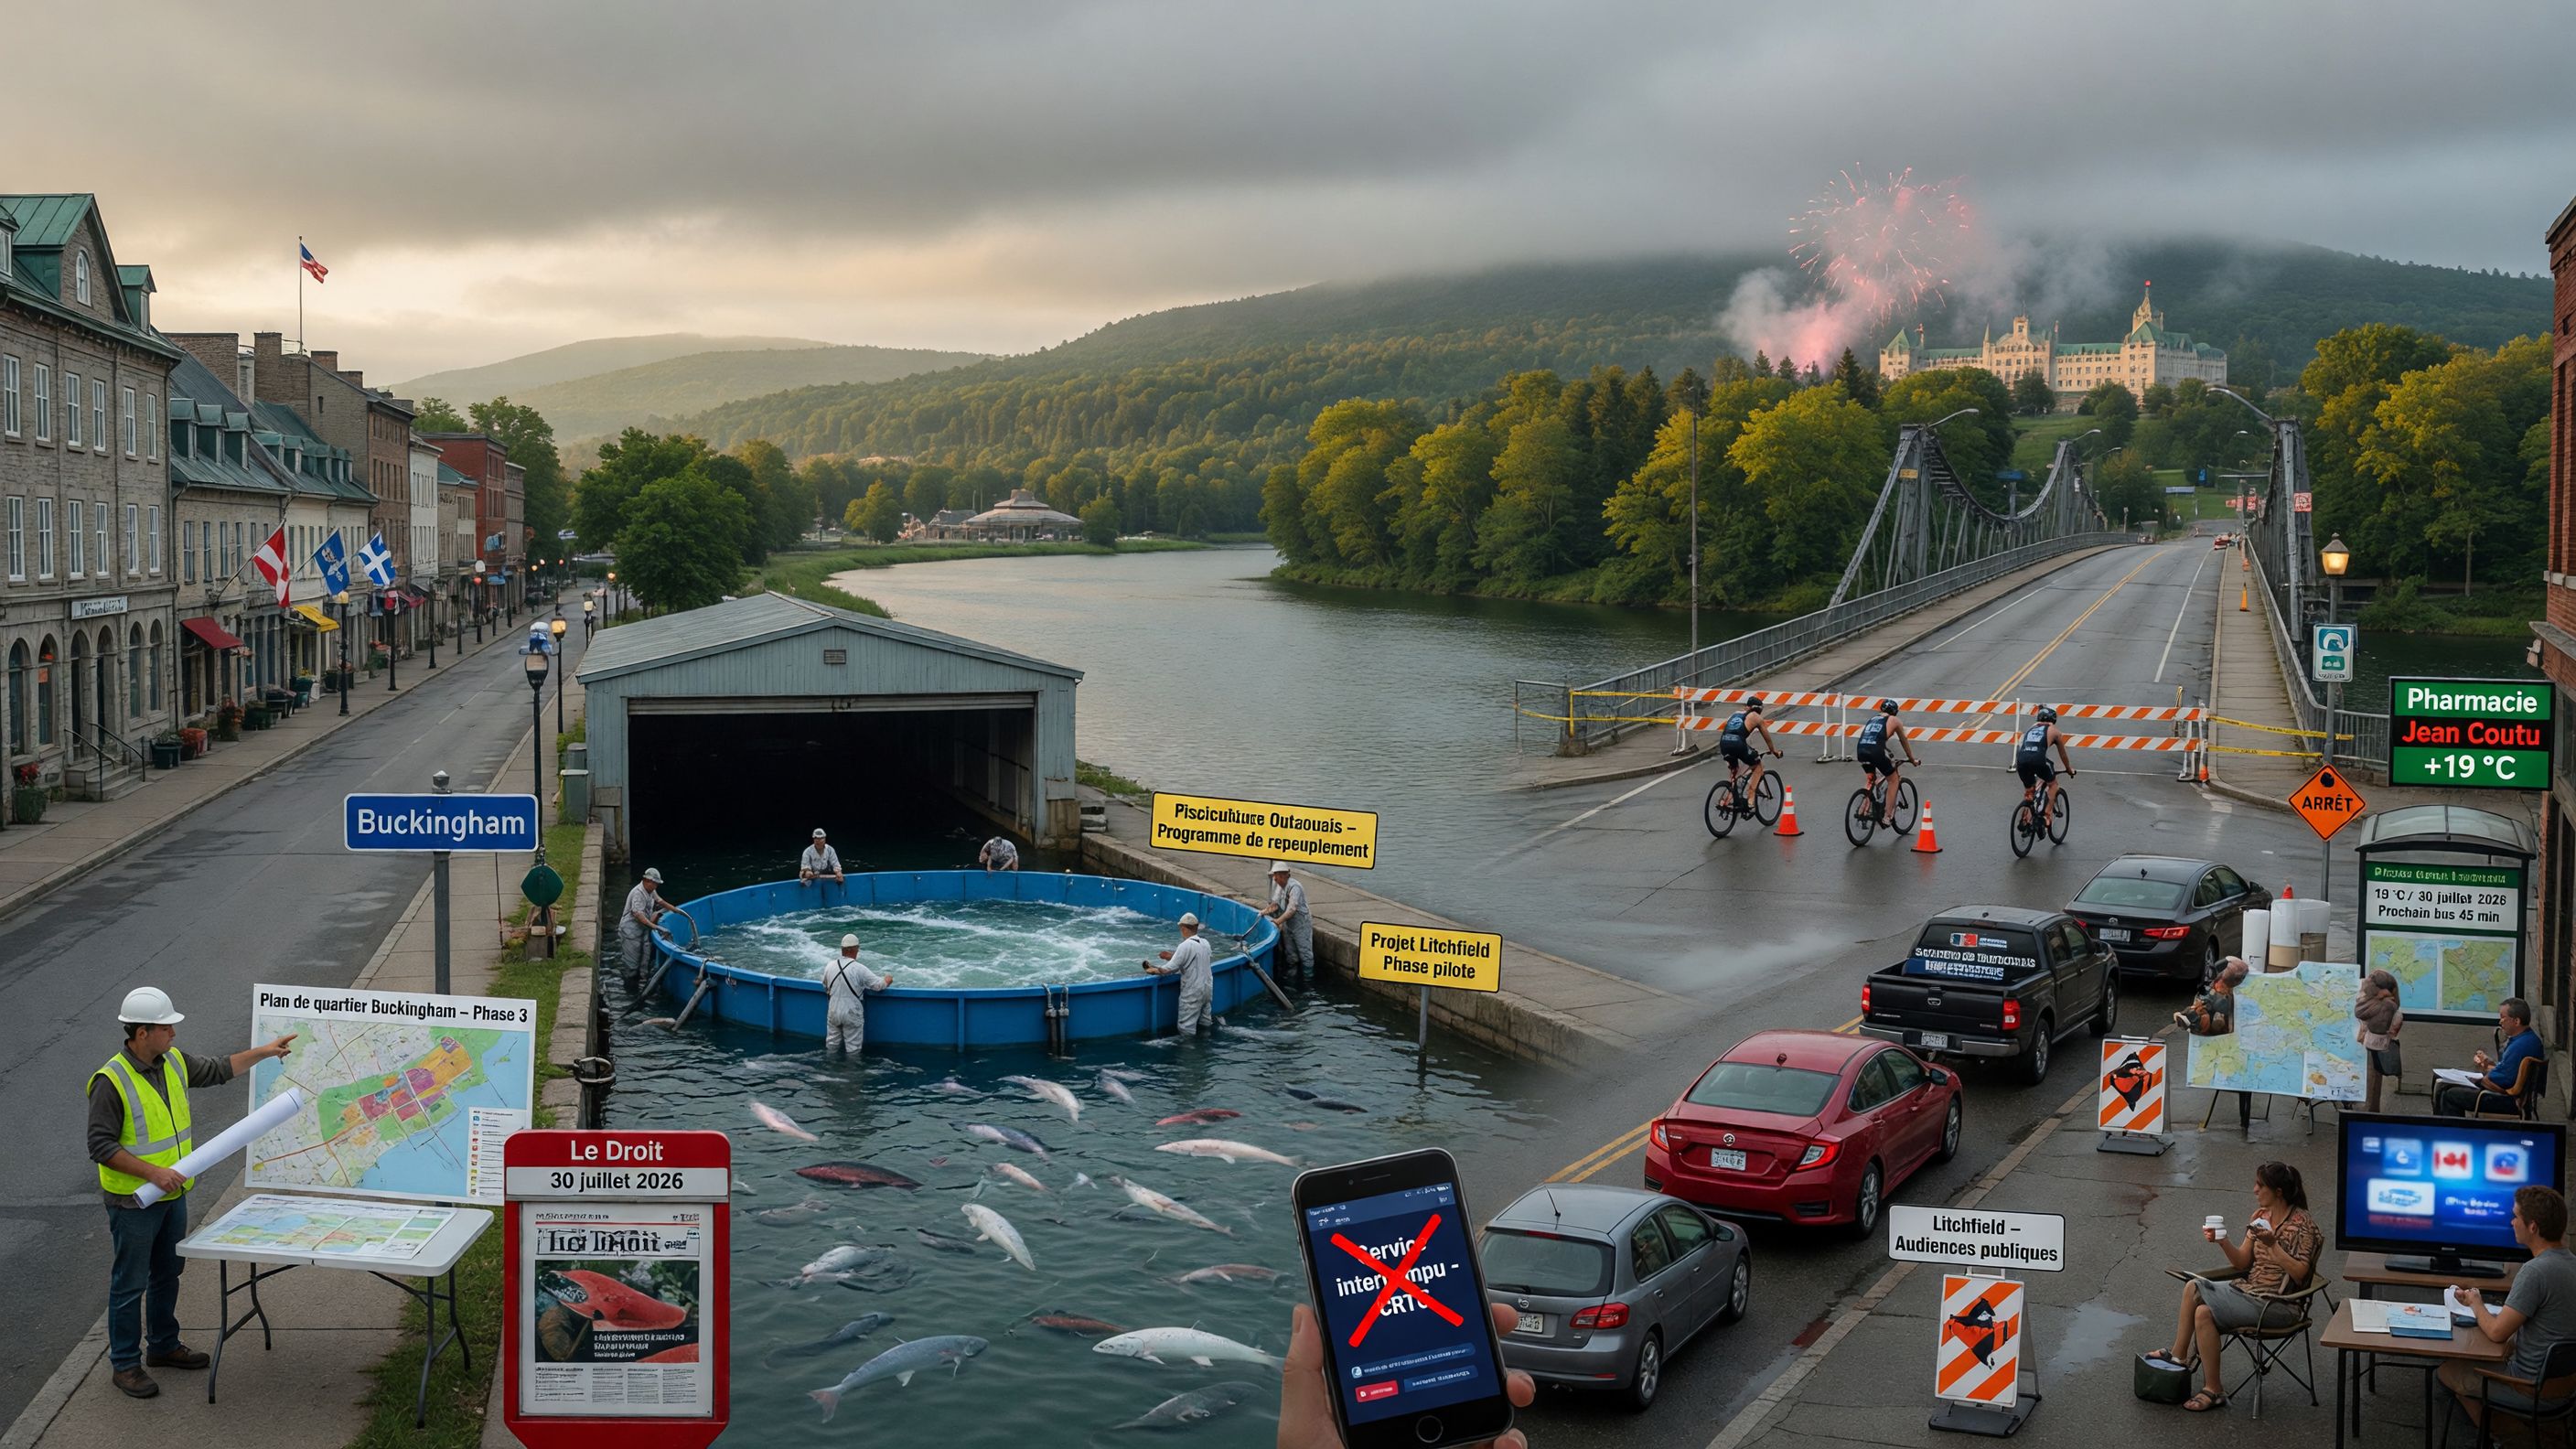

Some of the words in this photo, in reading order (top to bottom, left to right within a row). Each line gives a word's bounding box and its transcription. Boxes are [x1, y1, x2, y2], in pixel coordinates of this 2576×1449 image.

[2408, 688, 2538, 714] Pharmacie
[2402, 721, 2460, 744] Jean
[2468, 722, 2540, 746] Coutu
[2424, 754, 2475, 778] +19
[2483, 756, 2517, 780] °C
[2302, 794, 2354, 812] ARRÊT
[358, 809, 525, 842] Buckingham
[1270, 812, 1343, 833] Outaouais
[1157, 823, 1241, 845] Programme
[1246, 832, 1263, 847] de
[1268, 837, 1369, 858] repeuplement
[2418, 891, 2432, 902] 30
[2477, 894, 2507, 906] 2026
[2378, 905, 2431, 918] Prochain
[2434, 907, 2455, 920] bus
[2459, 909, 2474, 921] 45
[2477, 911, 2500, 922] min
[1371, 932, 1415, 952] Projet
[1420, 937, 1490, 959] Litchfield
[1383, 955, 1429, 974] Phase
[1433, 961, 1476, 979] pilote
[260, 993, 290, 1008] Plan
[294, 994, 310, 1009] de
[314, 996, 368, 1014] quartier
[371, 999, 456, 1020] Buckingham
[473, 1005, 515, 1022] Phase
[519, 1008, 528, 1023] 3
[571, 1140, 599, 1161] Le
[606, 1140, 664, 1162] Droit
[551, 1172, 574, 1189] 30
[579, 1172, 630, 1192] juillet
[636, 1172, 683, 1189] 2026
[1933, 1216, 2005, 1235] Litchfield
[1358, 1237, 1427, 1264] ervic
[1895, 1236, 1976, 1256] Audiences
[1980, 1242, 2058, 1263] publiques
